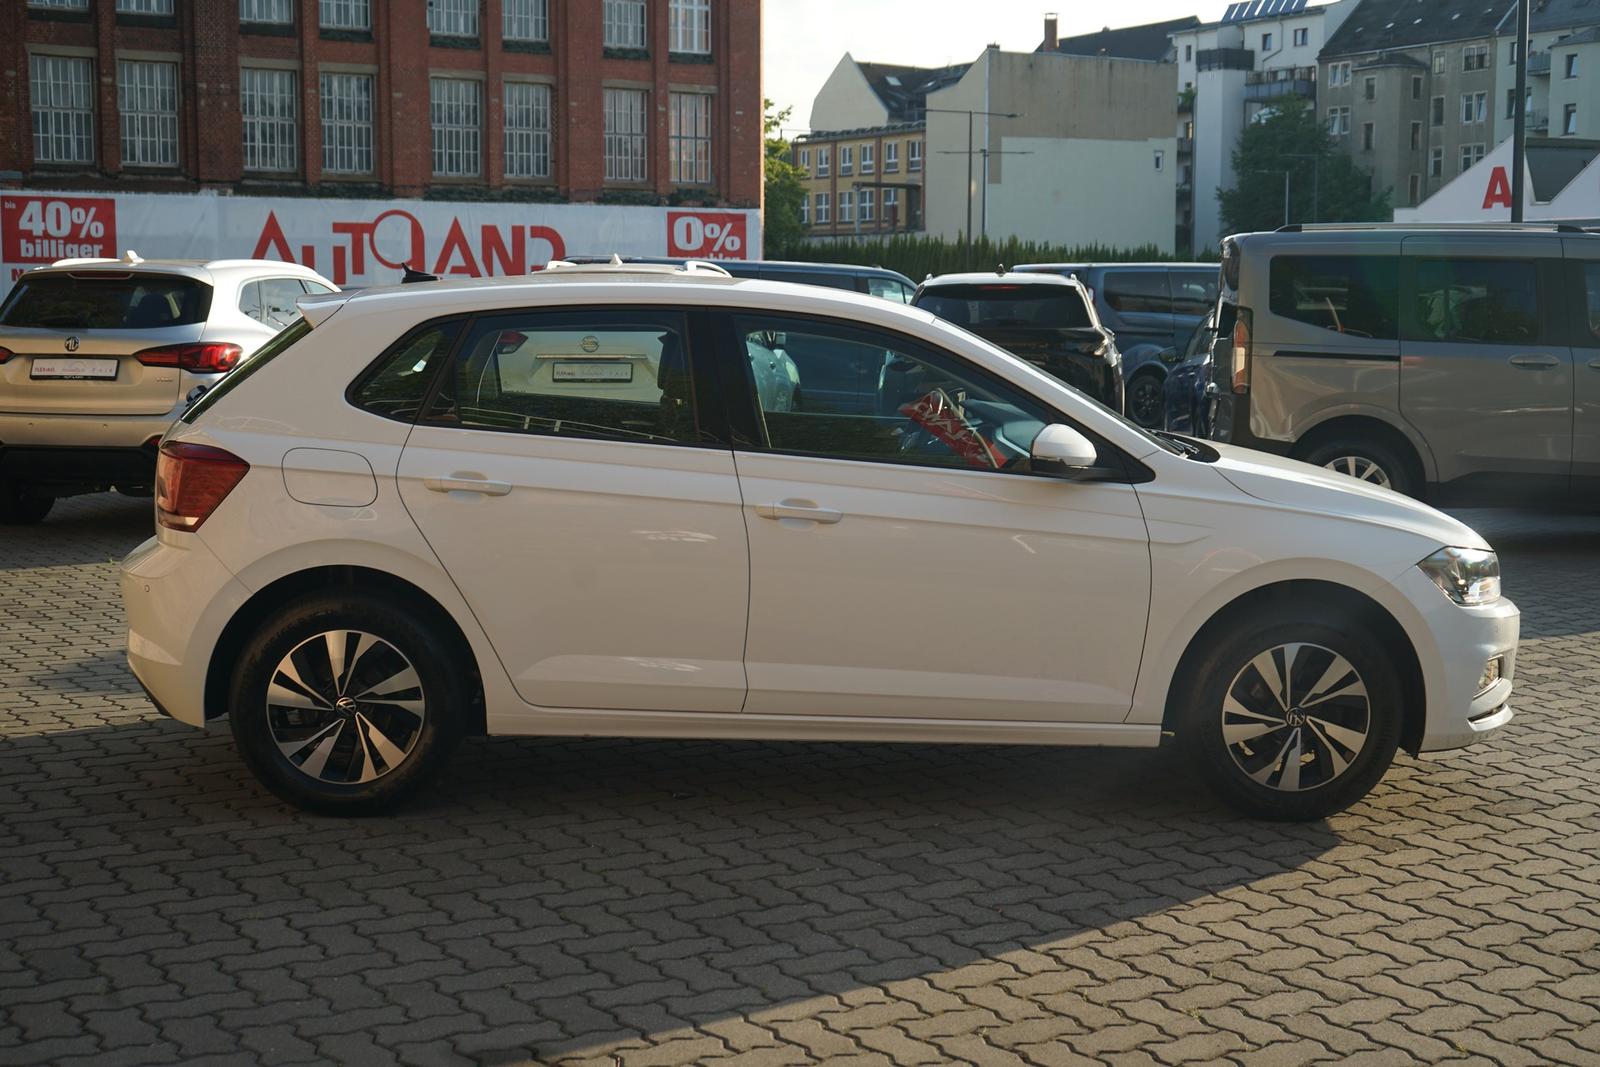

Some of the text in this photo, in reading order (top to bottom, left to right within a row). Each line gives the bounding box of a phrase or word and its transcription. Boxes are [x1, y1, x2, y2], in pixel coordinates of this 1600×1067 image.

[1482, 167, 1513, 209] A
[19, 201, 104, 238] 40%
[674, 216, 741, 252] 0%
[21, 240, 103, 258] billiger
